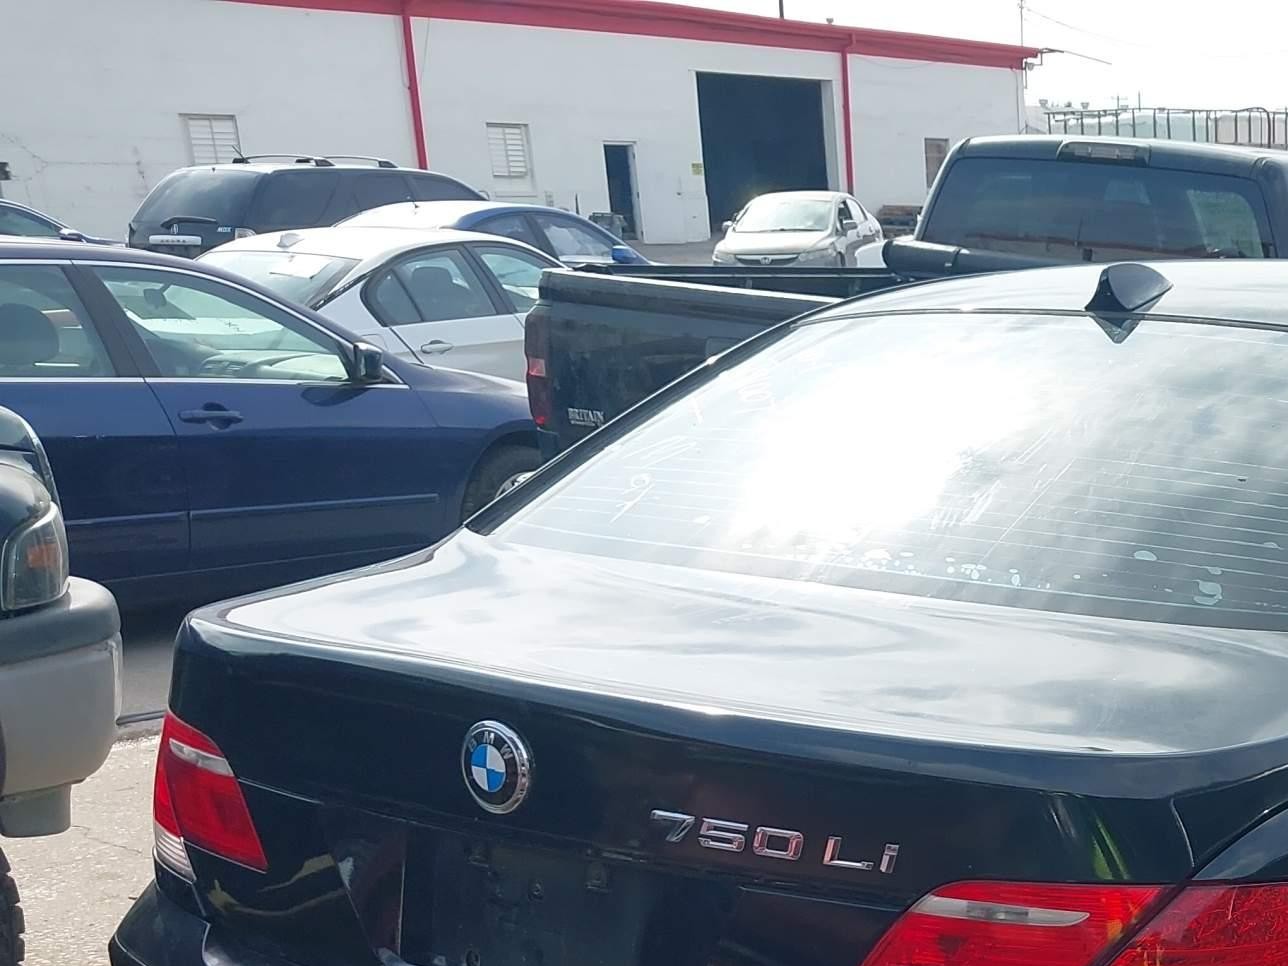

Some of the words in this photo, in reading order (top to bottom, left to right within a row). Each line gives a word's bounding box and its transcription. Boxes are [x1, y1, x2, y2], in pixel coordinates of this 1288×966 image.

[468, 731, 513, 759] BMW
[651, 809, 804, 860] 750
[823, 836, 899, 874] Li
